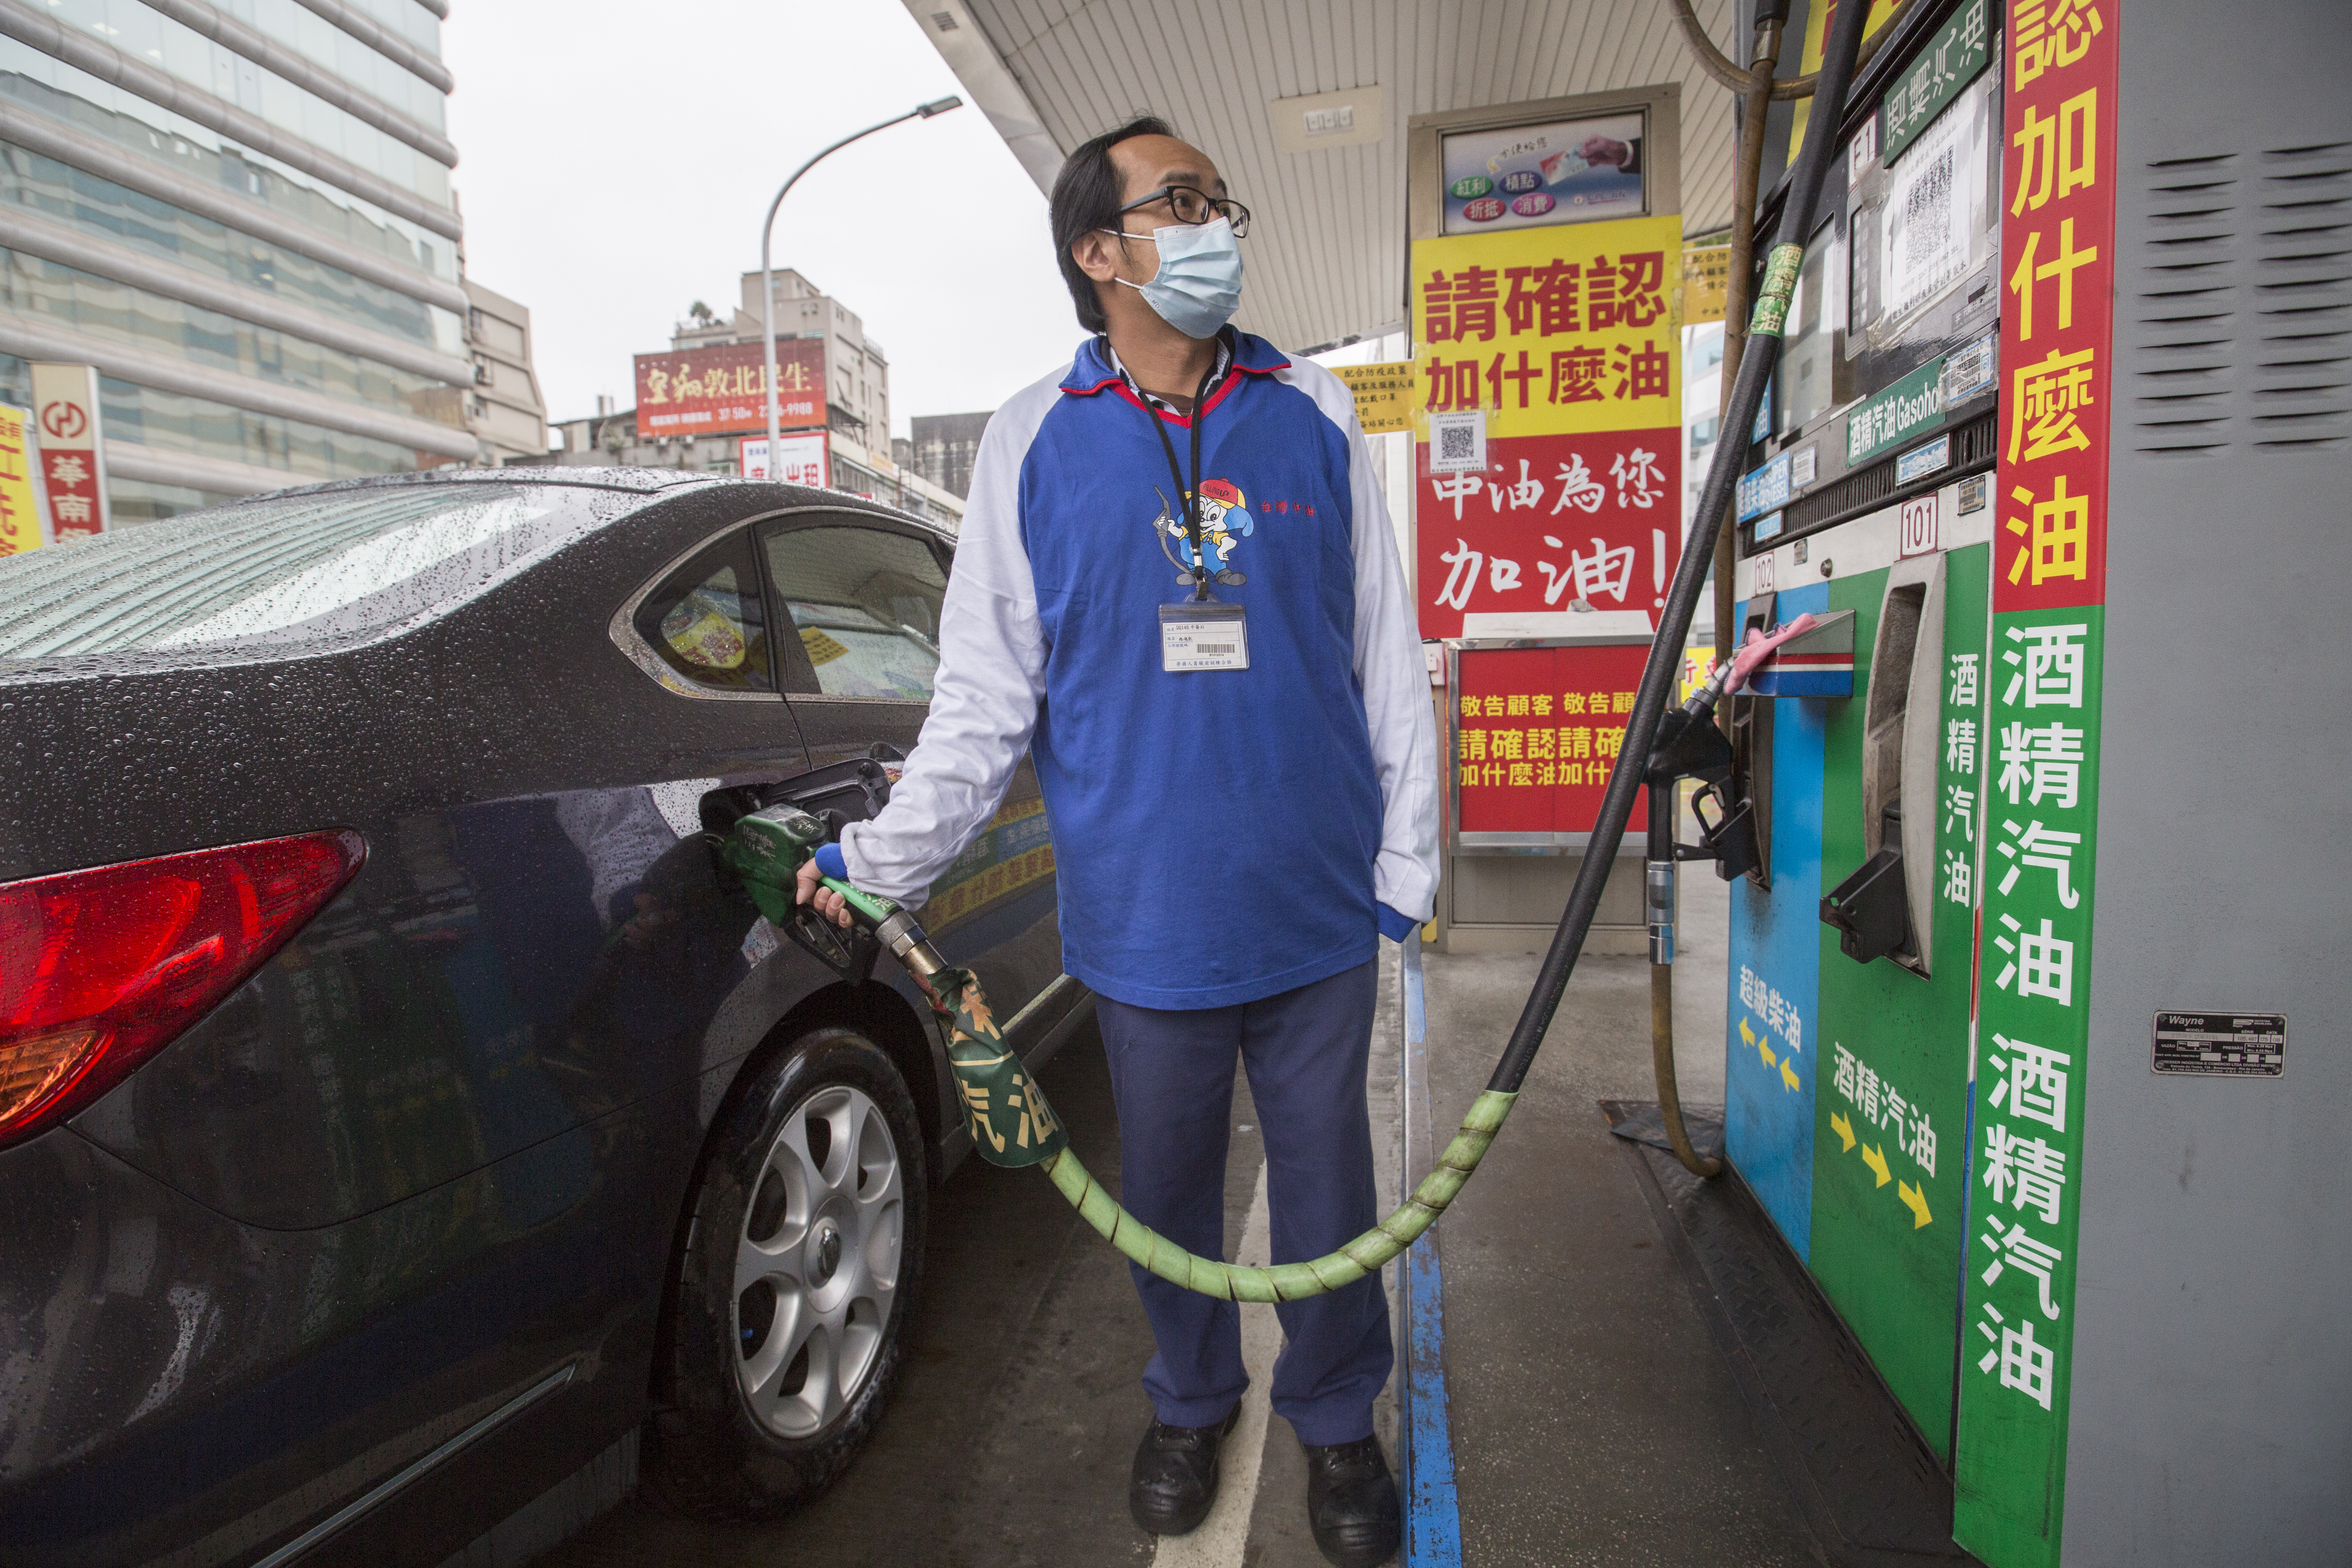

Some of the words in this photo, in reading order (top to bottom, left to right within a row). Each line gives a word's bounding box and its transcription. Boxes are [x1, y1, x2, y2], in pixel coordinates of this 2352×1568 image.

[1457, 178, 1487, 195] 紅利
[1505, 172, 1537, 190] 積點
[1470, 201, 1499, 219] 折抵
[1519, 196, 1548, 214] 消費
[1423, 250, 1666, 344] 請確認
[1344, 365, 1406, 378] 配合防疫政策
[1425, 340, 1669, 413] 加什麼油
[1850, 395, 1896, 458] 酒精汽油
[1432, 447, 1666, 521] 中油為您
[1261, 500, 1314, 516] 台灣中油
[1906, 502, 1933, 548] 101
[1758, 558, 1771, 589] 102
[1461, 694, 1553, 717] 敬告顧客
[1459, 727, 1555, 760] 請確認
[1459, 762, 1555, 786] 加什麼油
[1944, 654, 1979, 907] 酒精汽油
[1993, 624, 2087, 1007] 酒精汽油
[1740, 964, 1801, 1053] 超級柴油
[2169, 1016, 2204, 1026] Wayne
[1834, 1041, 1936, 1178] 酒精汽油
[1977, 1033, 2070, 1411] 酒精汽油
